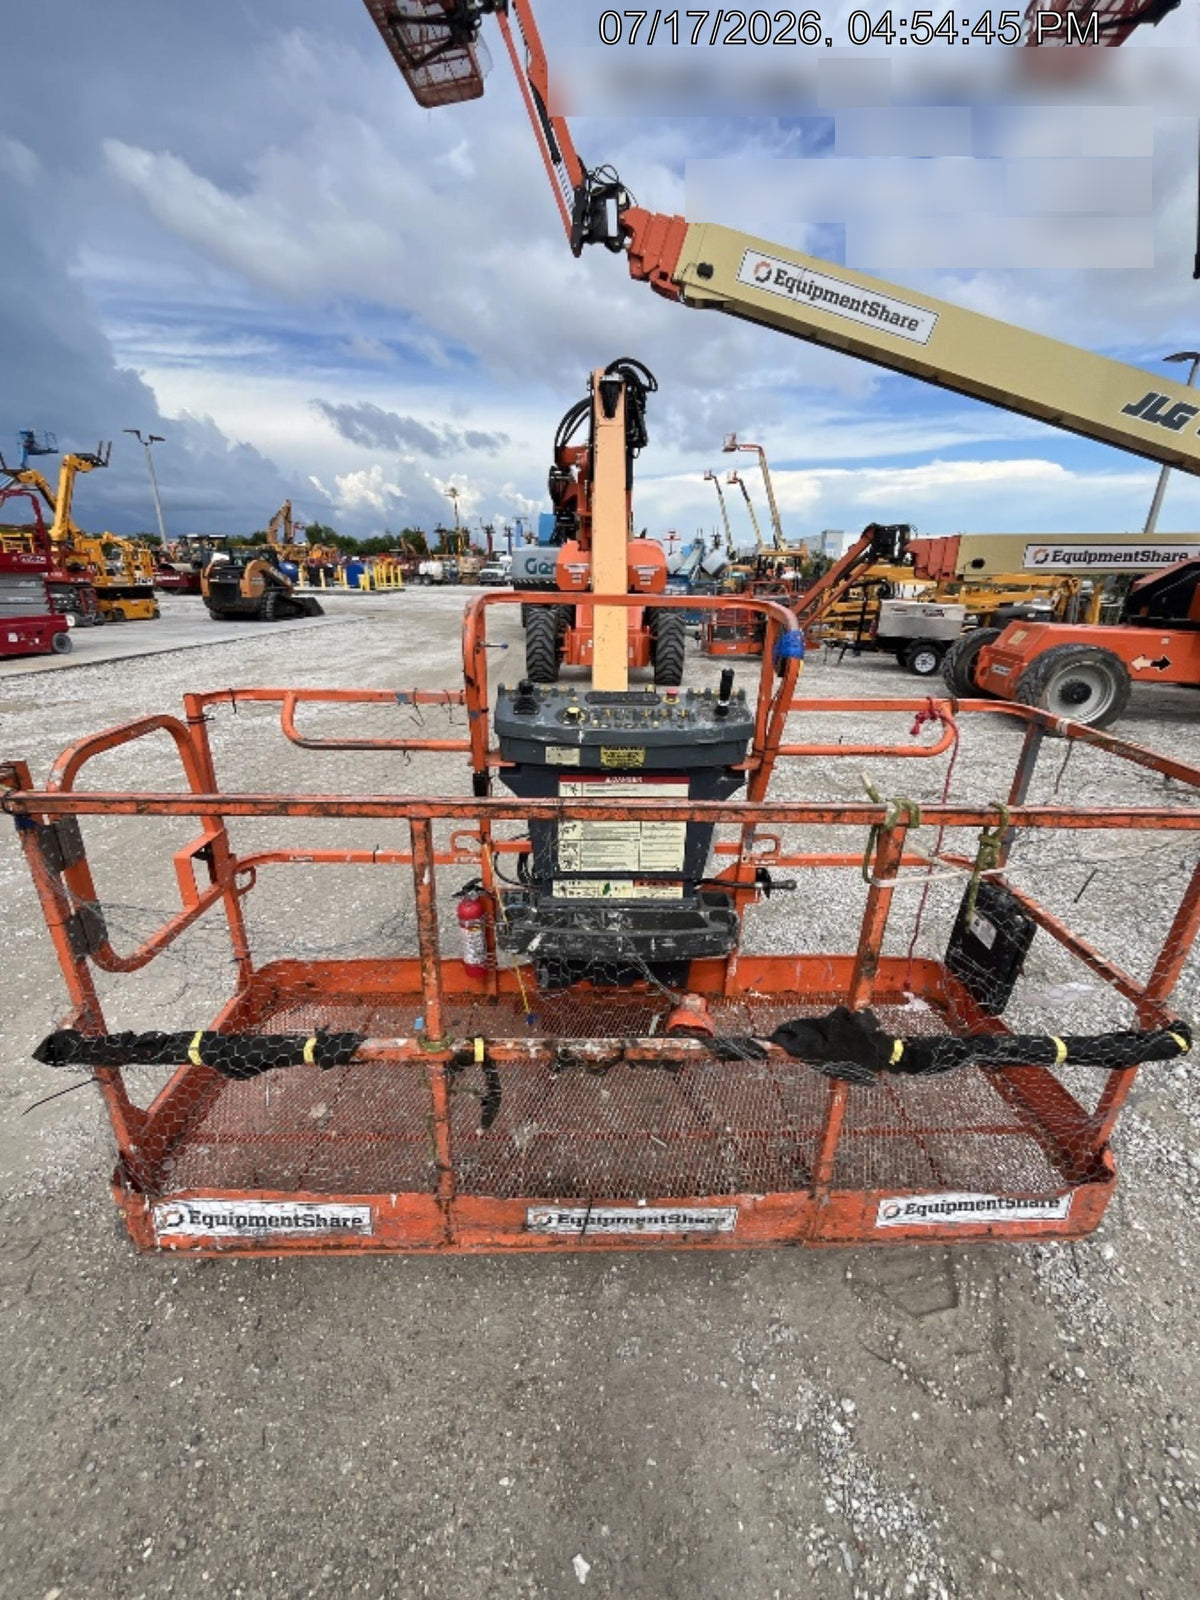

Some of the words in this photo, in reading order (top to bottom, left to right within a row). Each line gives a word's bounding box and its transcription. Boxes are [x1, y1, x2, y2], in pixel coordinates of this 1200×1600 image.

[773, 267, 920, 332] EquipmentShare
[1119, 391, 1200, 434] JLG
[1051, 550, 1188, 565] EquipmentShare
[189, 1209, 363, 1230] EquipmentShare
[557, 1213, 727, 1228] EquipmentShare
